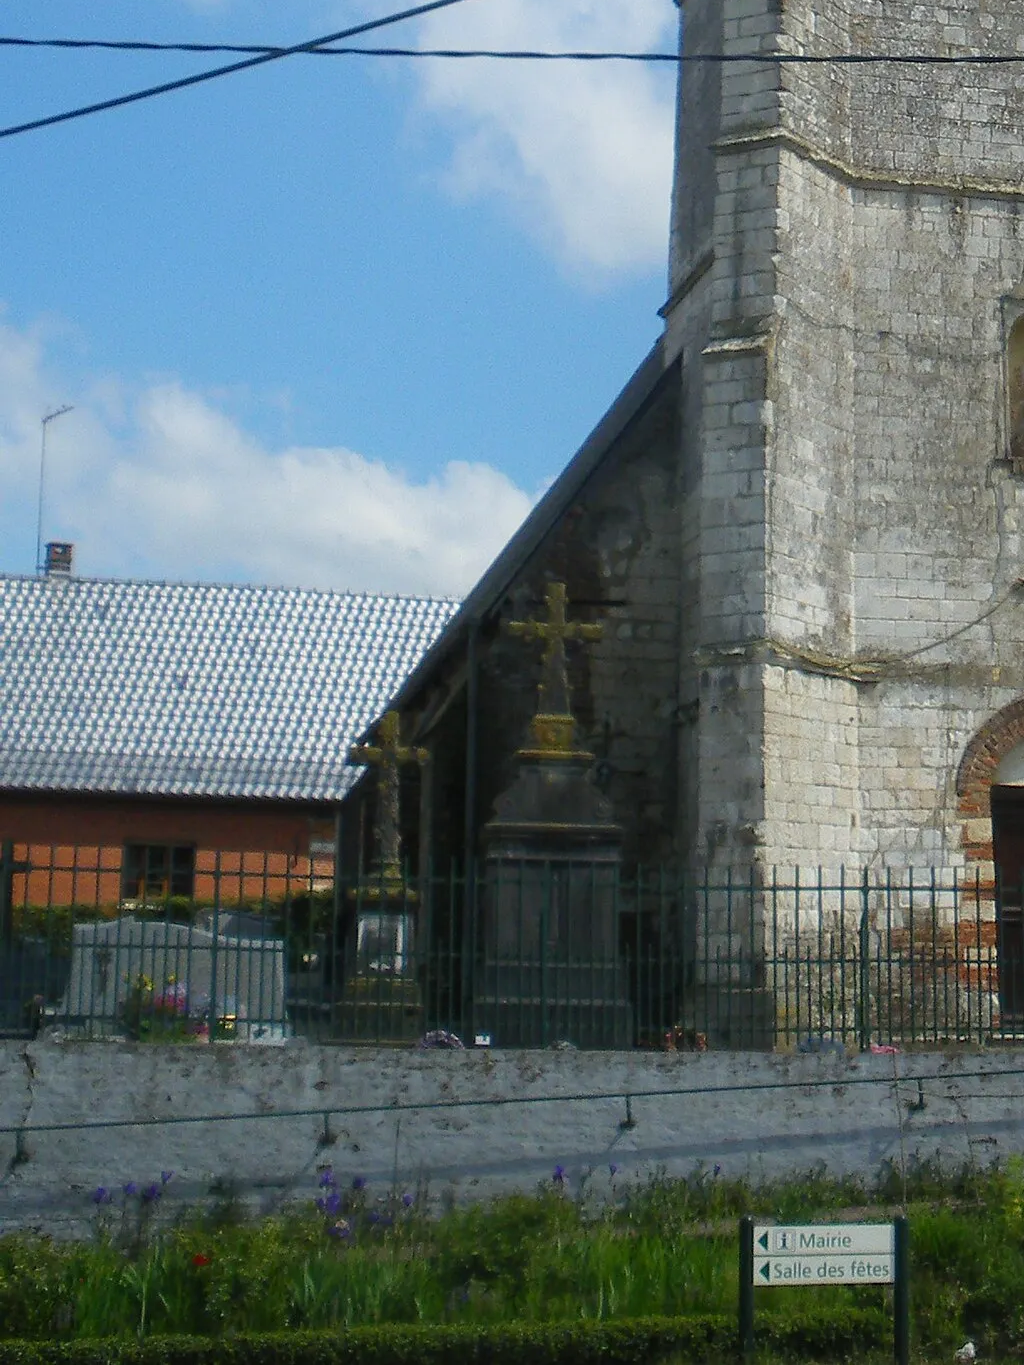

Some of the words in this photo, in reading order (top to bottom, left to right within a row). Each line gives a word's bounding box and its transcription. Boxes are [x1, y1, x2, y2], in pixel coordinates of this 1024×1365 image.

[800, 1231, 852, 1248] Mairie
[773, 1262, 812, 1279] Salle
[817, 1262, 845, 1278] des
[851, 1260, 889, 1277] fêtes
